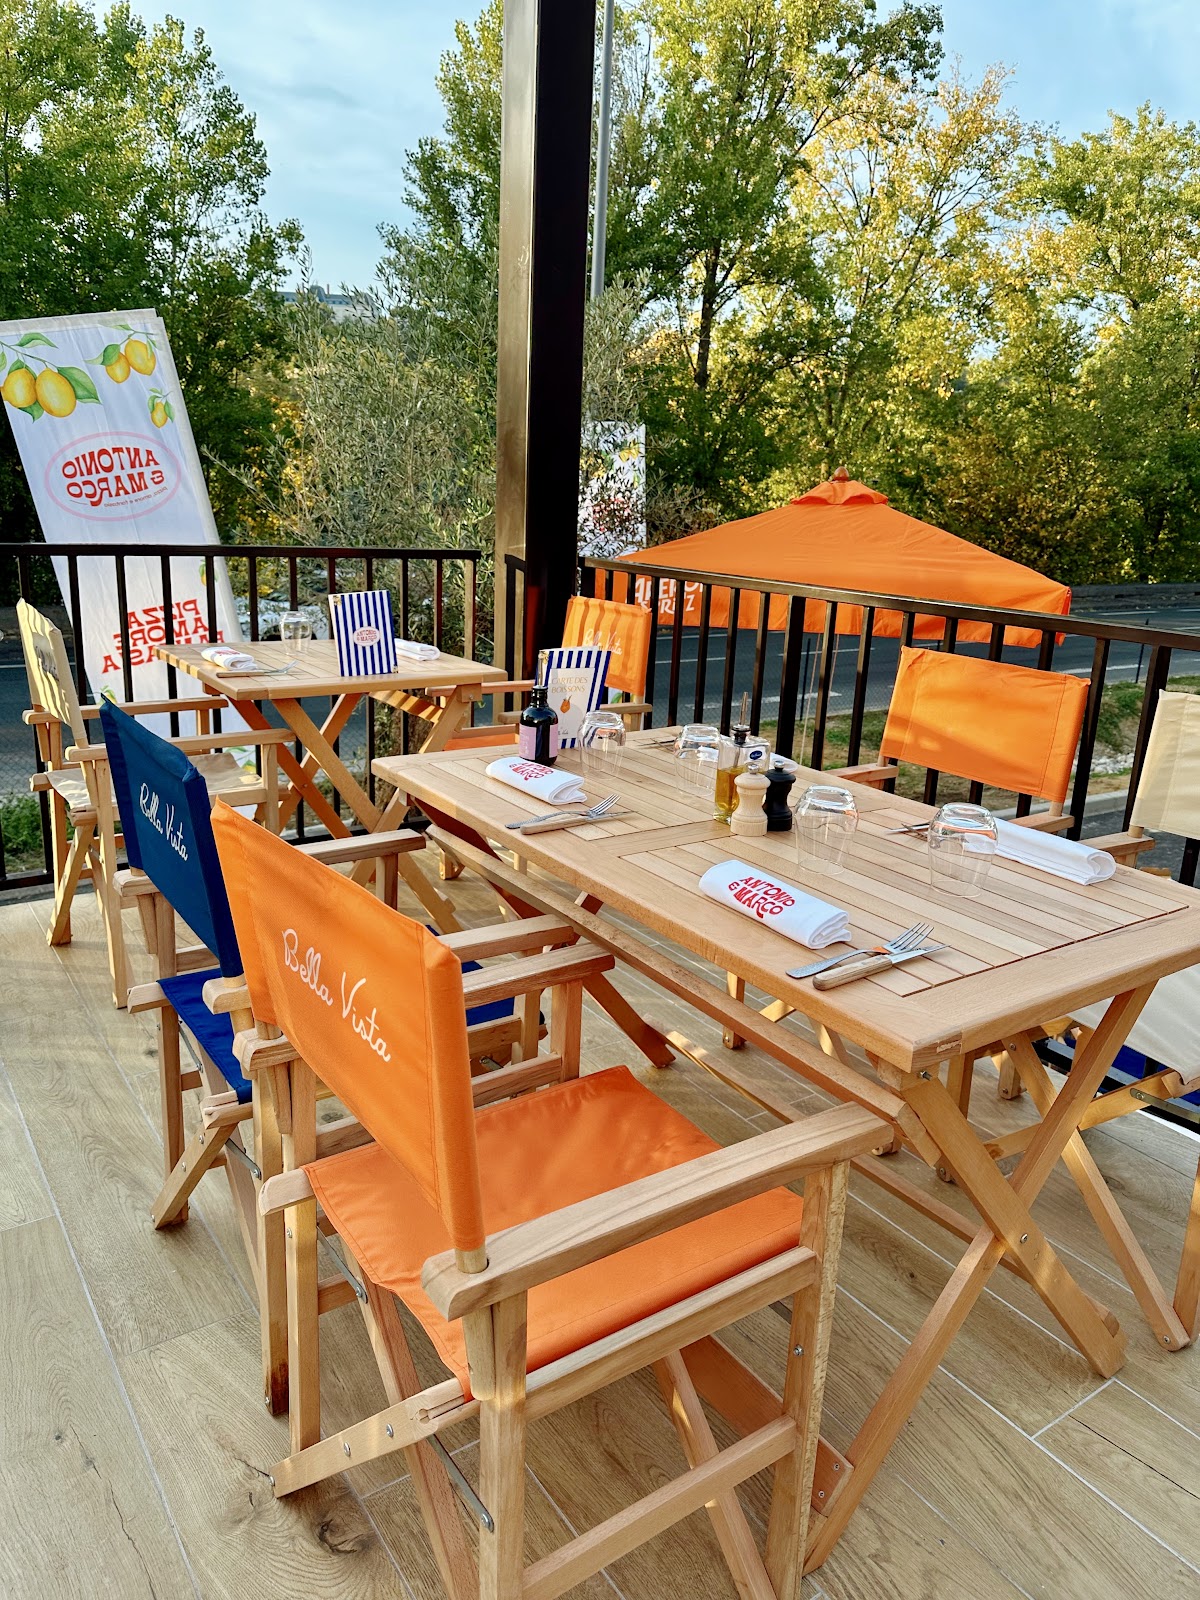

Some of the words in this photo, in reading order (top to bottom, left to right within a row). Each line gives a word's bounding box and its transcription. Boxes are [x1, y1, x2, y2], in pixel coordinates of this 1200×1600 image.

[551, 677, 574, 685] CARTE
[574, 676, 589, 684] DES
[551, 685, 586, 694] BOISSONS
[139, 782, 163, 835] Bella
[165, 803, 189, 861] Vista
[733, 886, 784, 919] MARCO
[740, 876, 796, 907] ANTONIO
[282, 928, 334, 1007] Bella
[340, 971, 392, 1063] Vista
